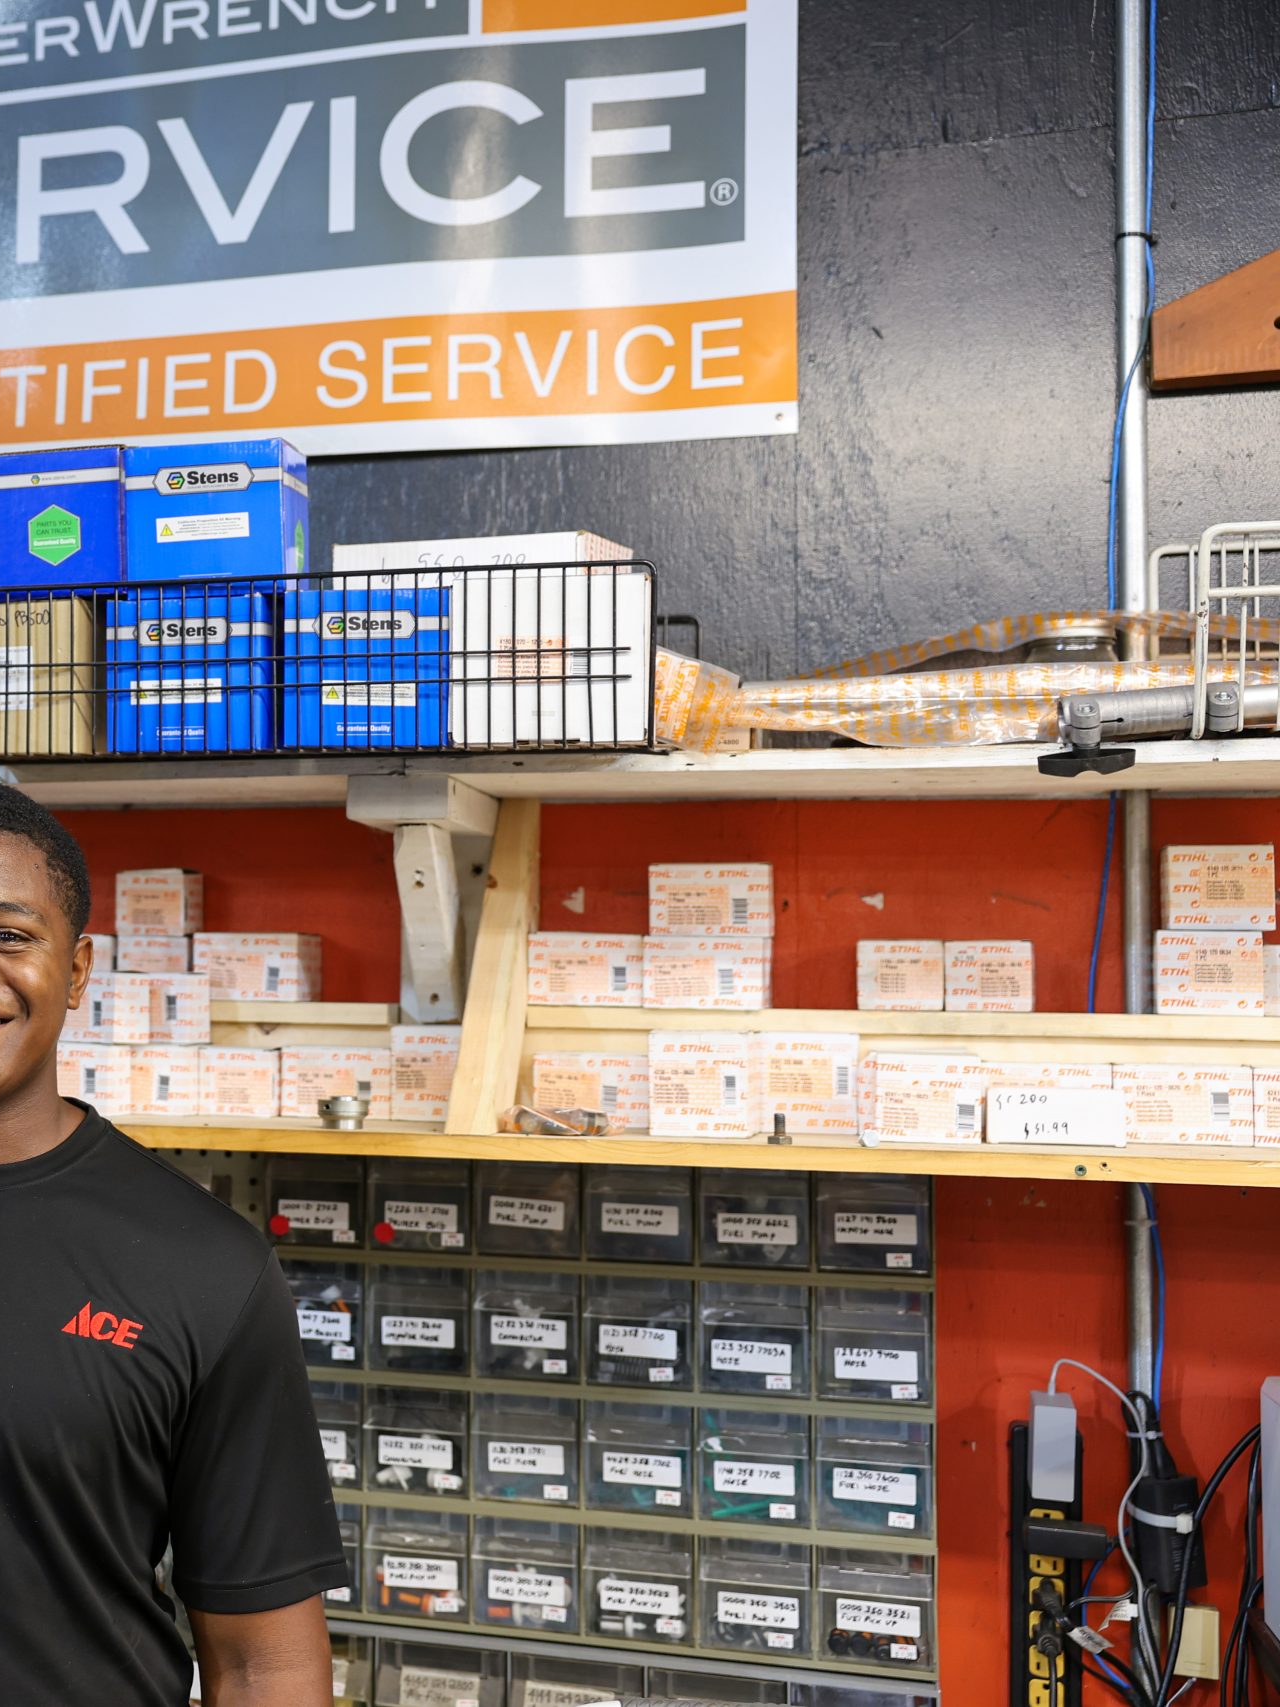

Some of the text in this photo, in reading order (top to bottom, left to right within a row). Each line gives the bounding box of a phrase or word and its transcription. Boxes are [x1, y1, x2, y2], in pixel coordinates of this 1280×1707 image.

[317, 319, 746, 406] SERVICE
[186, 470, 239, 485] Stens
[348, 616, 402, 631] Stens
[166, 623, 218, 638] Sens
[336, 725, 391, 733] Guranteed Quality
[1172, 853, 1209, 863] STIHL
[719, 870, 750, 878] STIHL
[1172, 884, 1201, 893] STIH
[1173, 915, 1211, 924] STIHL
[719, 926, 751, 934] STIHL
[254, 938, 280, 946] STIHL
[595, 940, 624, 948] STIHL
[1160, 937, 1197, 946] STIHL
[712, 942, 743, 950] STIHL
[890, 945, 922, 953] STIHL
[981, 946, 1014, 954] STIHL
[951, 960, 979, 968] STIH
[1160, 968, 1190, 976] STIH
[952, 988, 977, 996] STIH
[595, 995, 624, 1003] STIHL
[713, 998, 744, 1006] STIHL
[983, 1002, 1014, 1010] STIHL
[1161, 999, 1198, 1008] STIHL
[419, 1036, 448, 1044] STIHL
[679, 1044, 714, 1053] STIHL
[791, 1043, 825, 1051] STIHL
[229, 1053, 256, 1061] STIHL
[345, 1053, 373, 1061] STIHL
[1058, 1069, 1092, 1077] STIHL
[1112, 1071, 1139, 1080] TIHL
[1194, 1072, 1230, 1080] STIHL
[1228, 1088, 1255, 1097] STIH
[419, 1094, 448, 1102] STIHL
[1019, 1094, 1047, 1105] 200
[142, 1104, 168, 1112] STIHL
[229, 1106, 255, 1114] STIHL
[680, 1107, 714, 1115] STIHL
[791, 1104, 825, 1112] STIHL
[713, 1123, 748, 1131] STIHL
[822, 1119, 857, 1128] STIHL
[1230, 1119, 1255, 1127] STIH
[1195, 1133, 1232, 1142] STIHL
[607, 1218, 662, 1228] FUEL PUMP
[60, 1300, 144, 1350] ACE
[716, 1357, 740, 1366] HOSE
[844, 1360, 867, 1368] HOSE
[759, 1470, 781, 1480] 7702
[723, 1478, 748, 1487] HOSE
[863, 1484, 890, 1493] HOSE
[886, 1608, 910, 1619] 3521
[885, 1619, 897, 1628] UP
